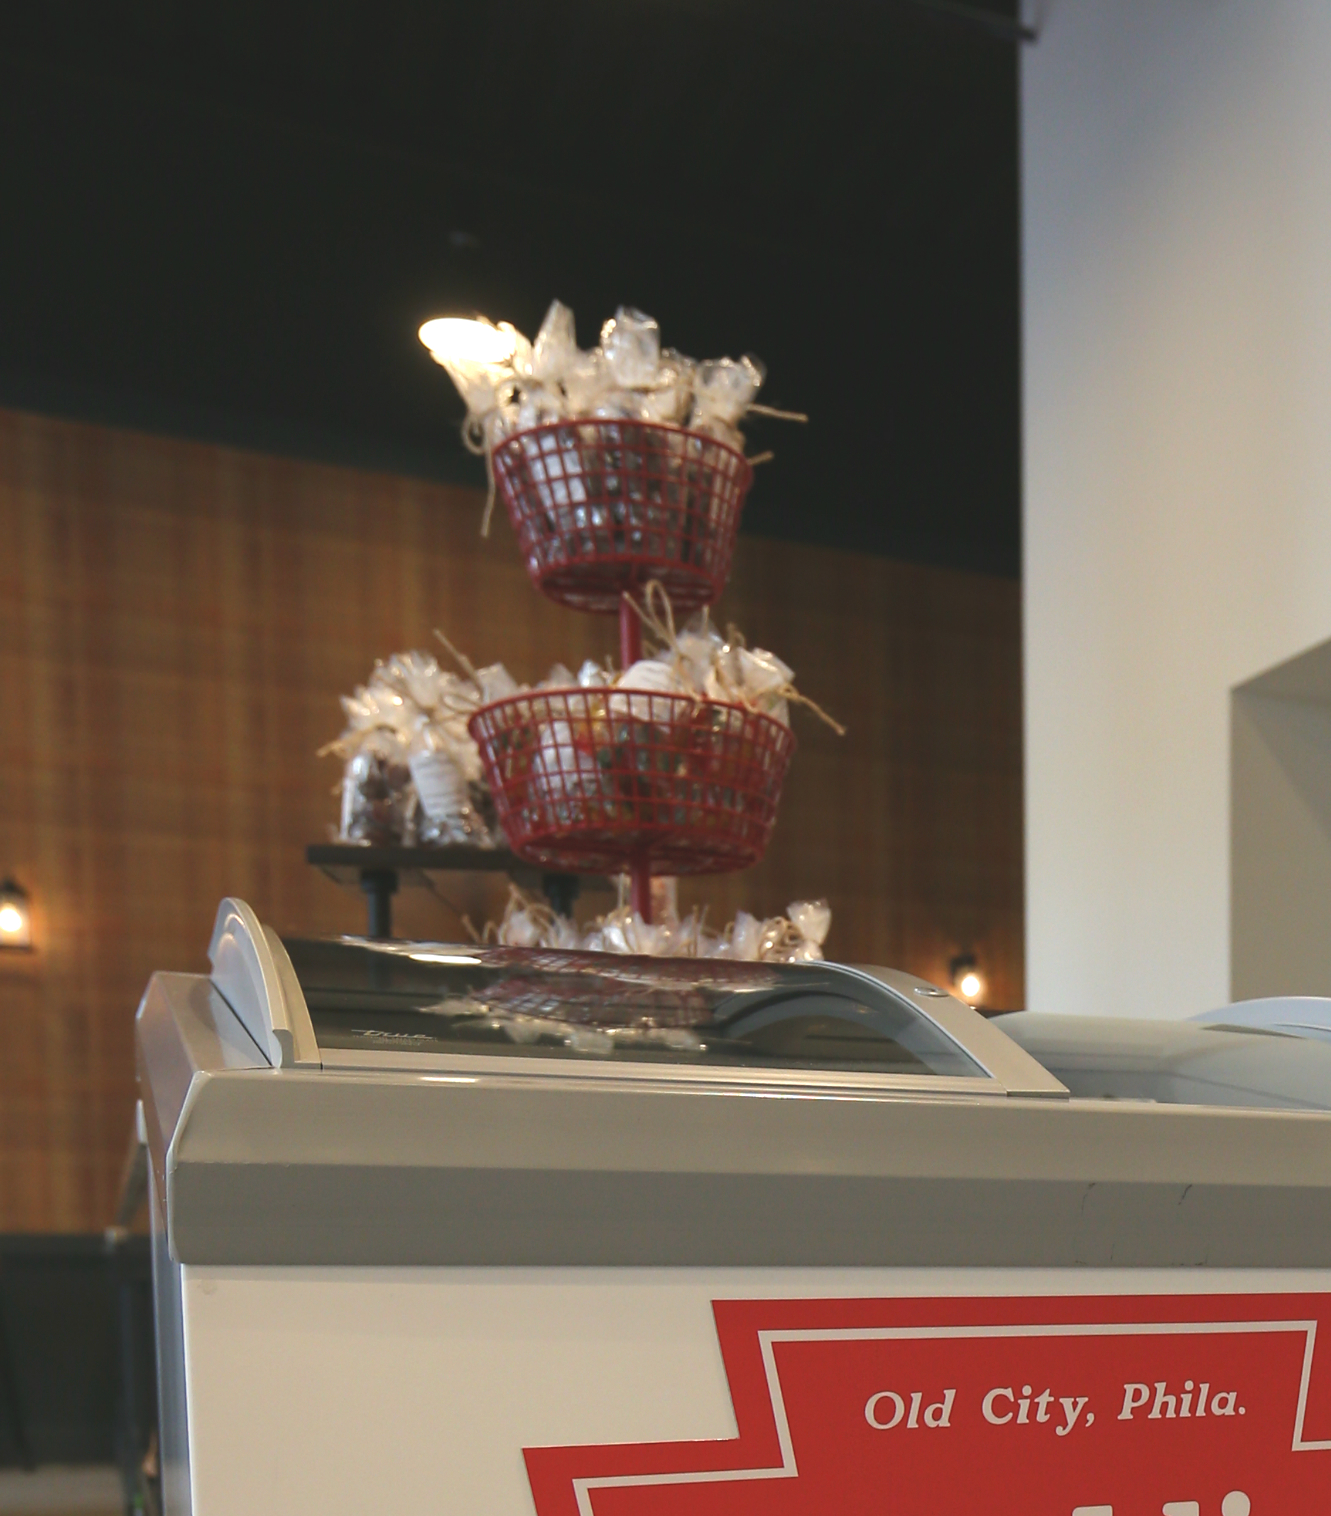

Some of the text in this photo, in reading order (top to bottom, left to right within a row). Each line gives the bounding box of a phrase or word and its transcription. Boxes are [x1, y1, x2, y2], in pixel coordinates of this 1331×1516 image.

[864, 1380, 1246, 1437] Old City, Phila.
